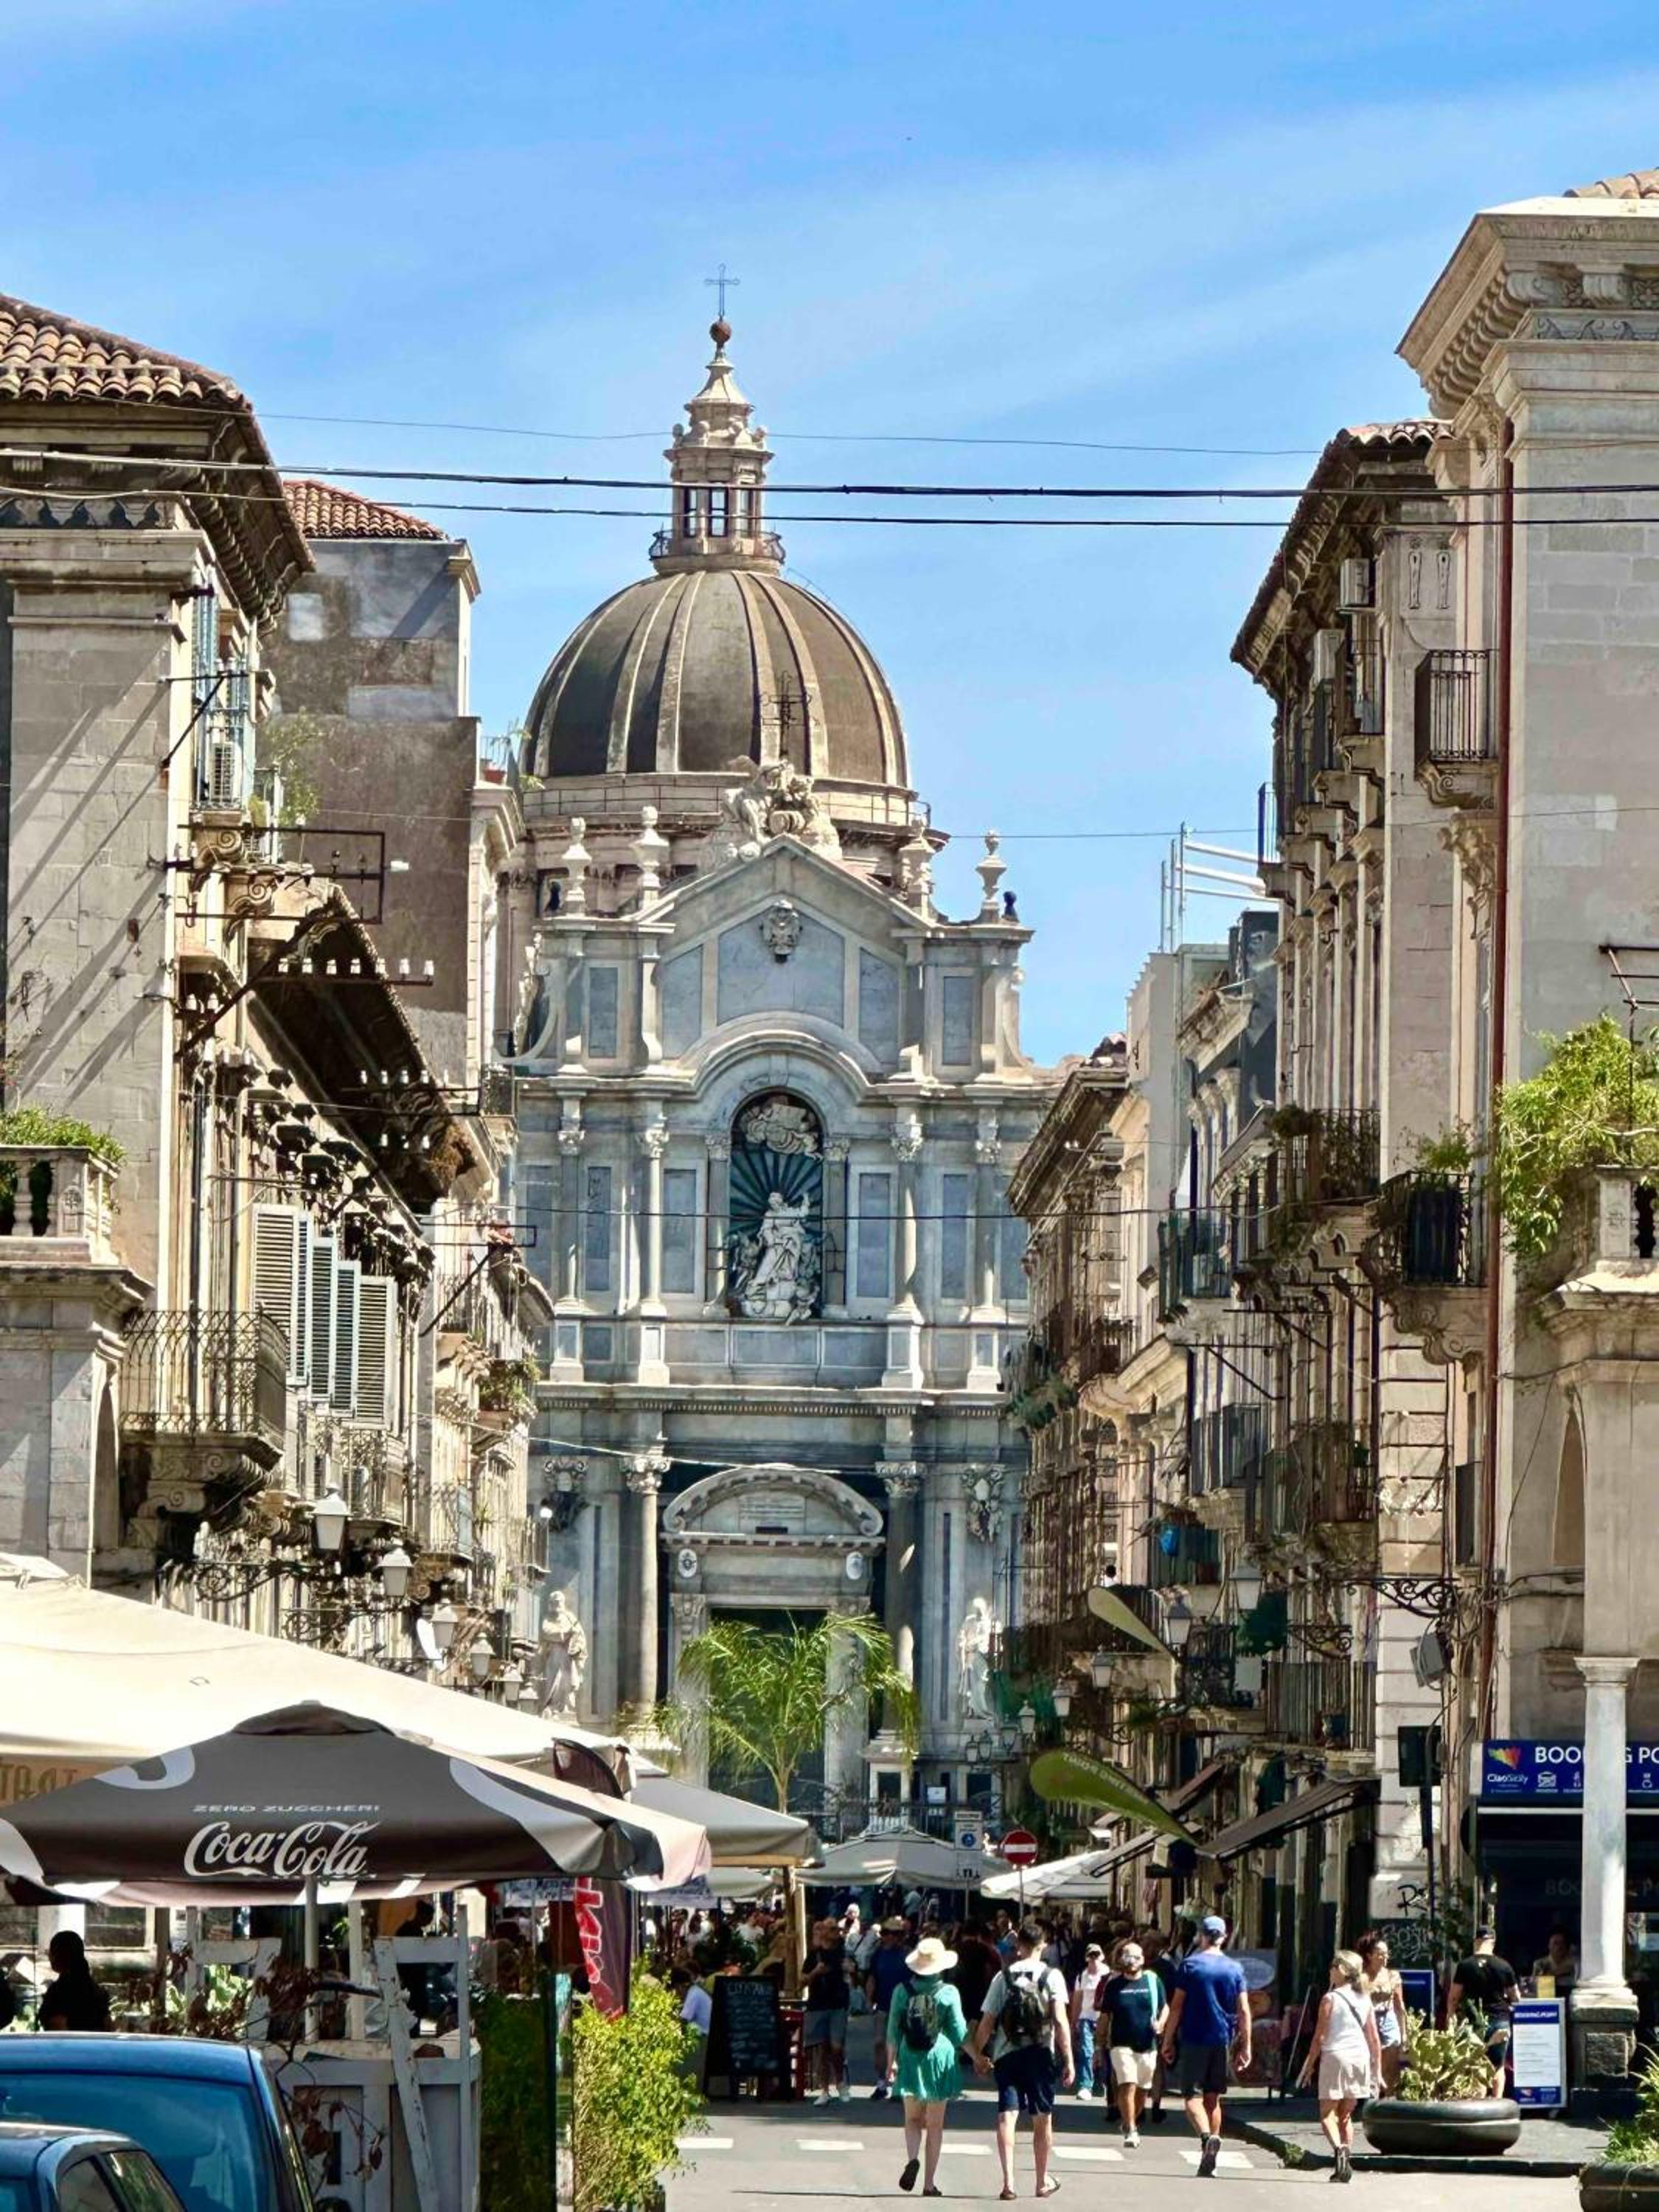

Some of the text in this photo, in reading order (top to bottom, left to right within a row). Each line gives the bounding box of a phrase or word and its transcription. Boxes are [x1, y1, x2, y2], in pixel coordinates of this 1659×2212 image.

[192, 1804, 380, 1812] ZERO ZUCCHERI
[184, 1820, 381, 1877] Coca-Cola
